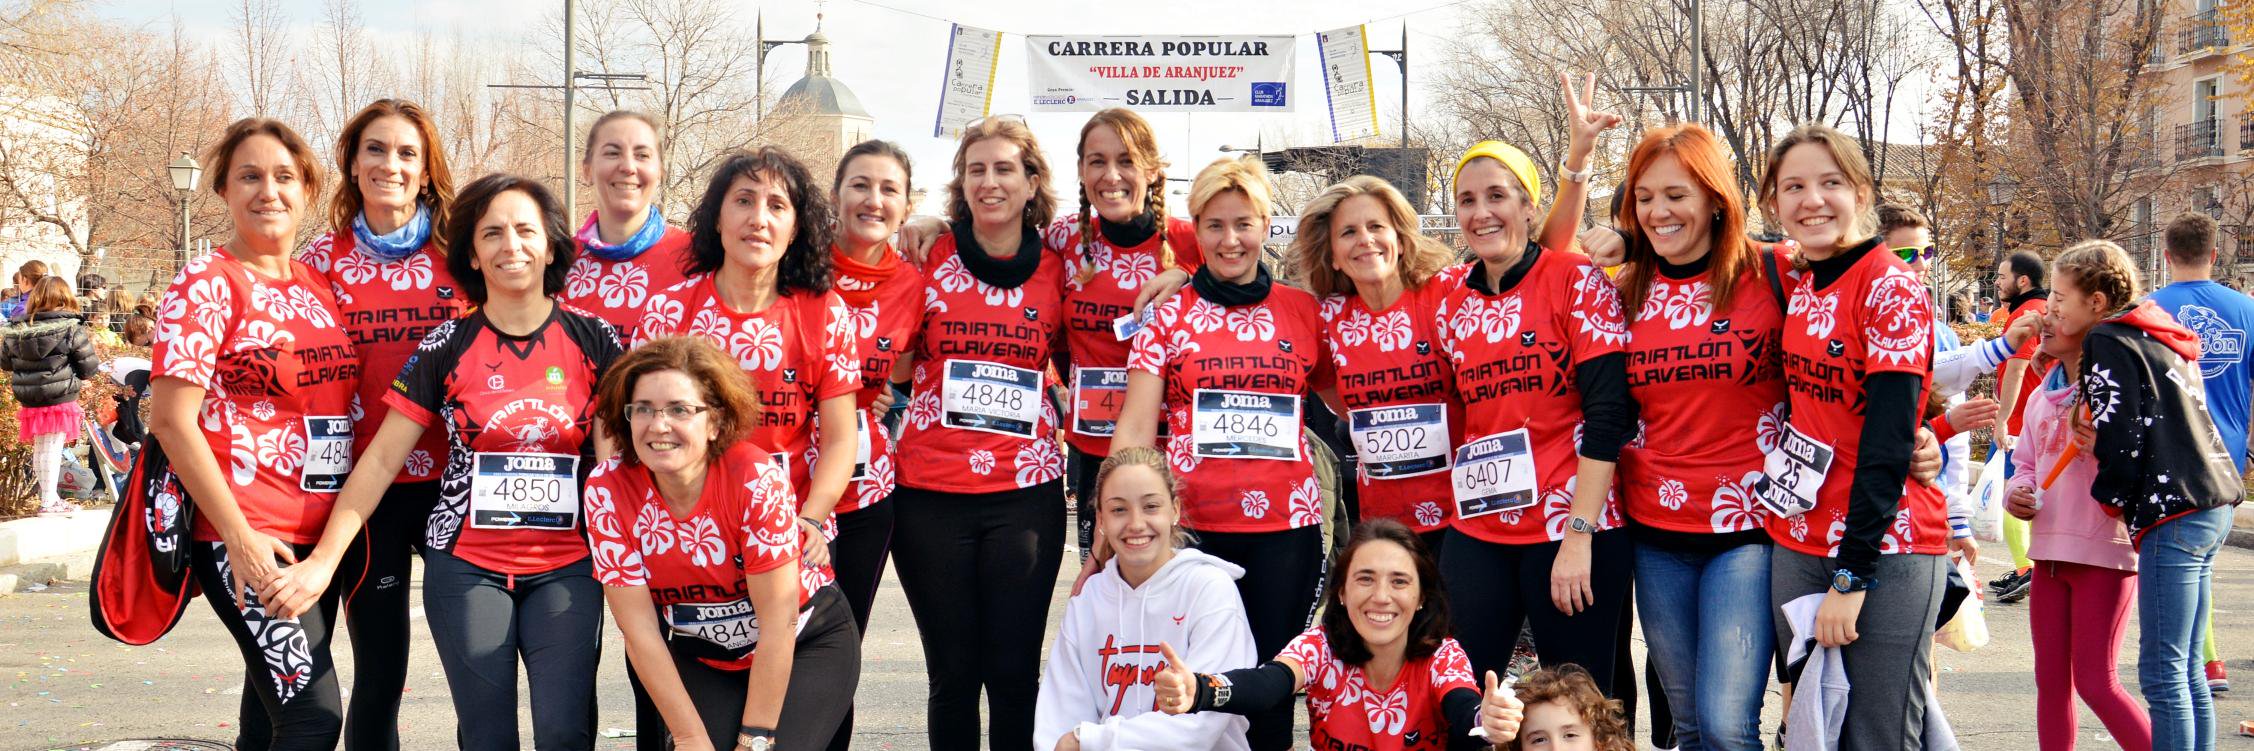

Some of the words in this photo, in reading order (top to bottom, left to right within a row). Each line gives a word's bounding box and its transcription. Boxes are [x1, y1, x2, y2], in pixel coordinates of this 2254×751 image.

[1048, 41, 1155, 56] CARRERA
[1162, 41, 1269, 56] POPULAR
[1143, 66, 1161, 78] DE
[1126, 89, 1215, 105] SALIDA
[940, 321, 1040, 343] TRIATLÓN
[941, 340, 1039, 360] CLAVERÍA
[1194, 353, 1297, 374] TRIATLÓN
[1341, 359, 1441, 389] TRIATLÓN
[962, 383, 1023, 411] 4848
[1344, 377, 1444, 408] CLAVERÍA
[482, 398, 575, 434] TRIATLÓN
[1213, 413, 1278, 437] 4846
[1366, 427, 1427, 454] 5202
[1376, 451, 1420, 462] MARGARITA
[1466, 458, 1512, 490] 6407
[1778, 458, 1802, 491] 25
[493, 477, 560, 503] 4850
[506, 503, 550, 512] MILAGROS
